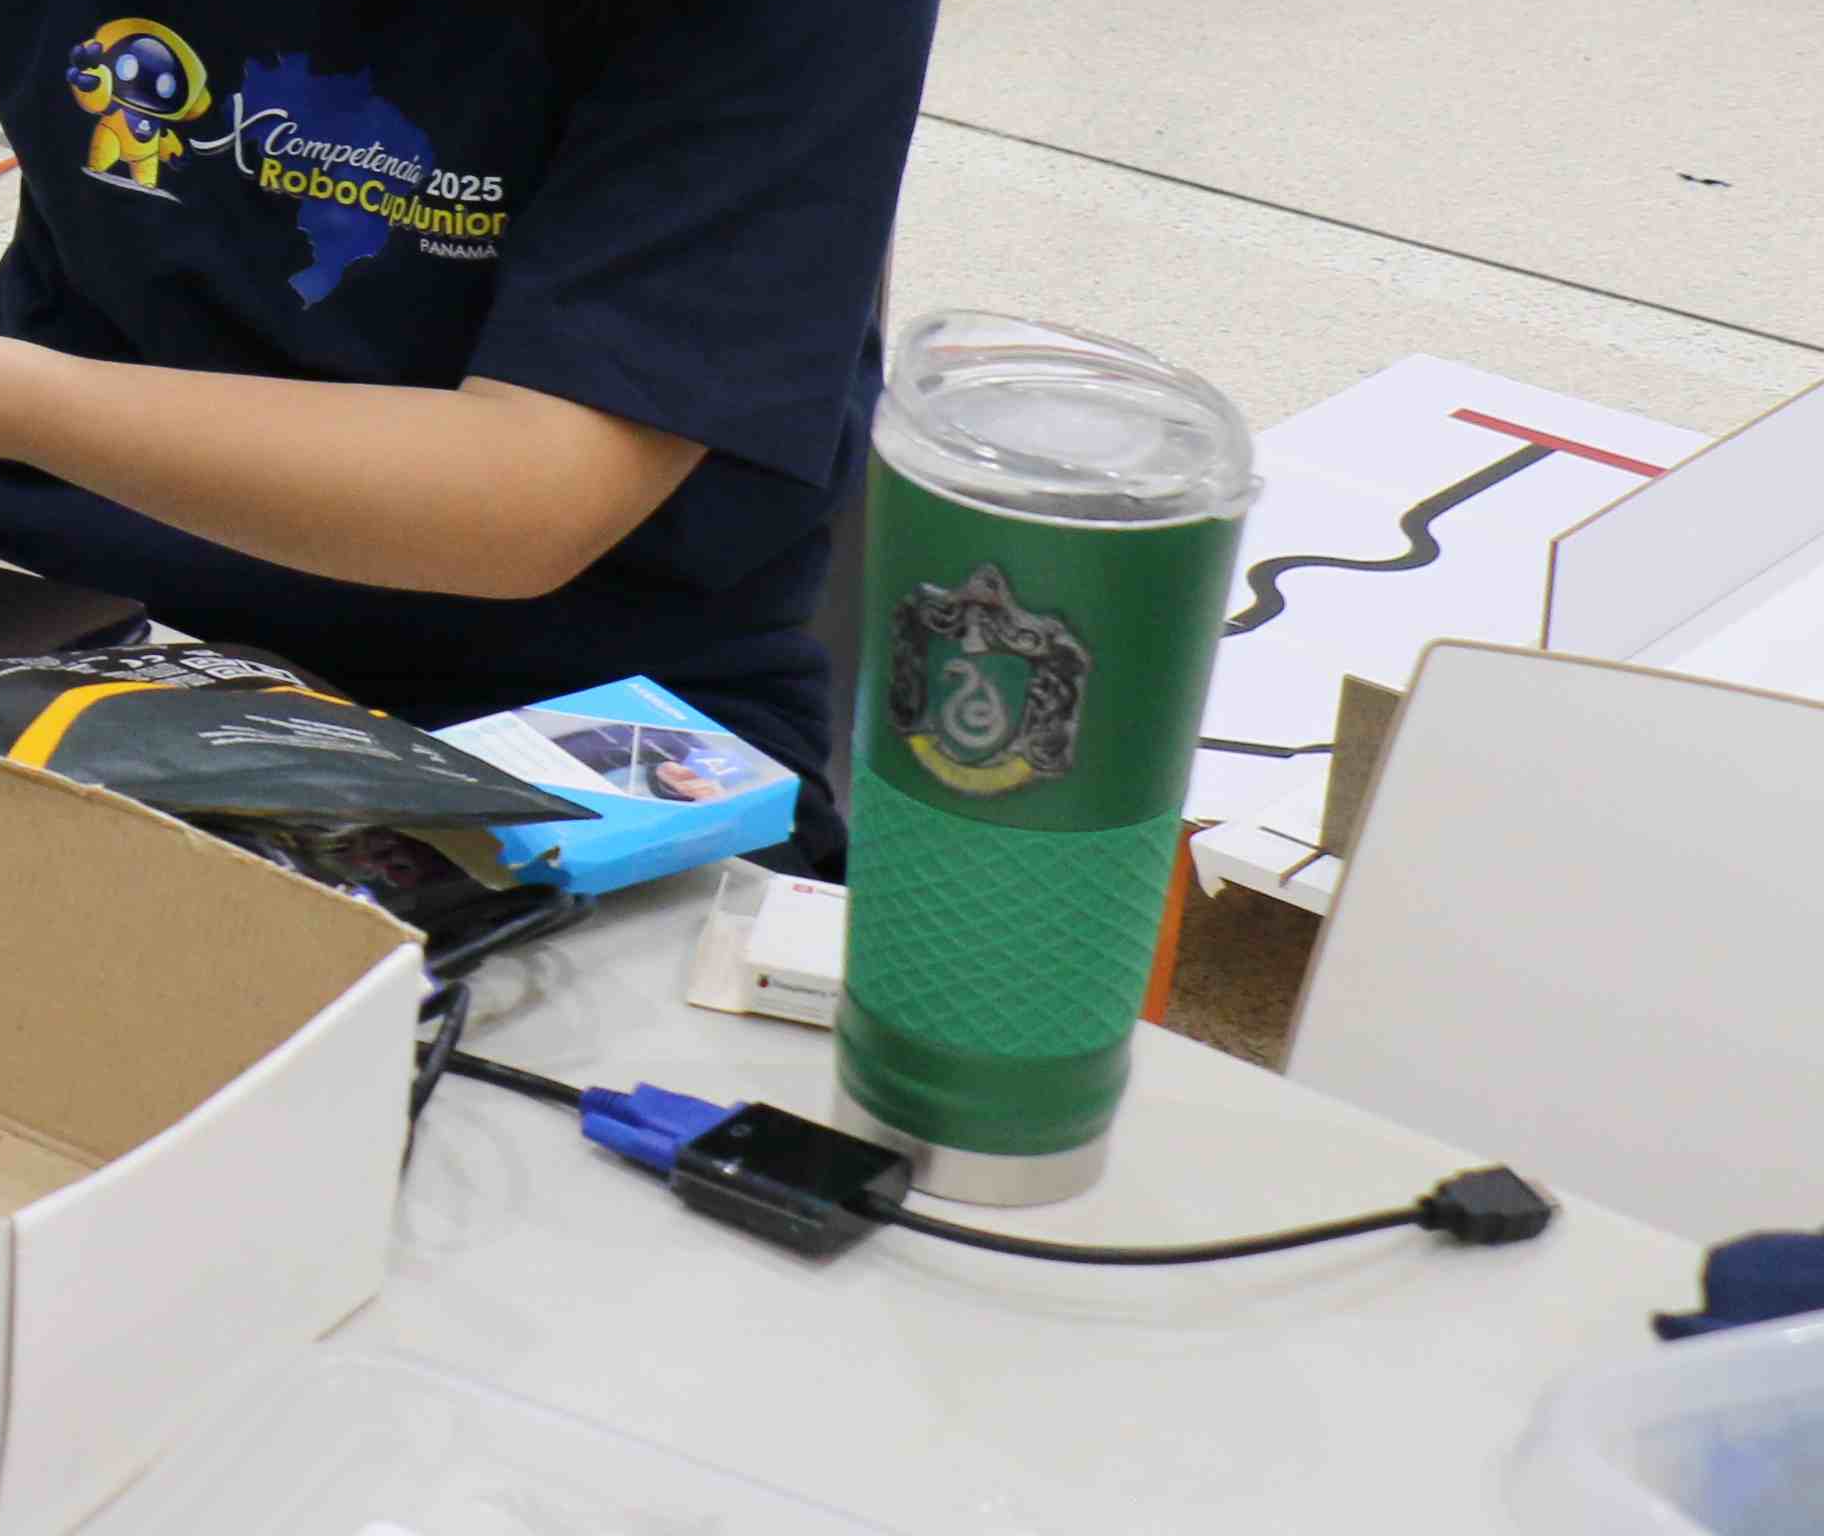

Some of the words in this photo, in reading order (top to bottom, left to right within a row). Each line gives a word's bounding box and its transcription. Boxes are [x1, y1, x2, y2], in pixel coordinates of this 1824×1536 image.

[189, 93, 289, 175] X
[264, 121, 423, 185] Competencia
[425, 169, 503, 202] 2025
[259, 158, 508, 236] RoboCupJunior
